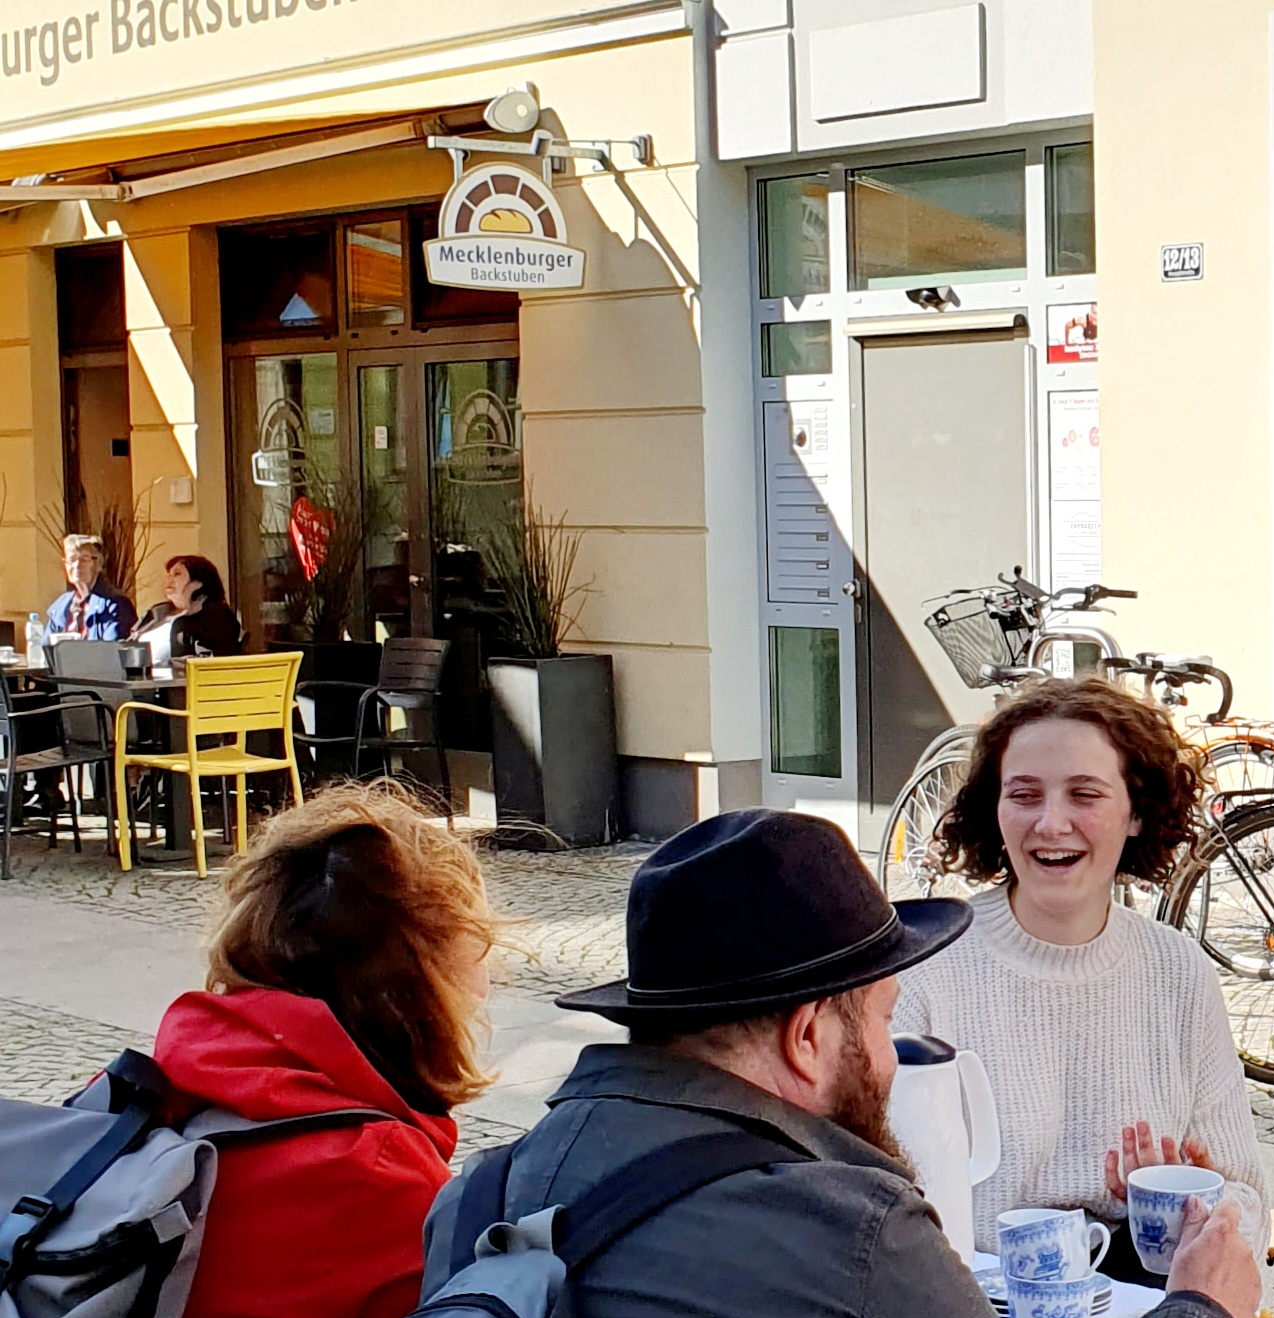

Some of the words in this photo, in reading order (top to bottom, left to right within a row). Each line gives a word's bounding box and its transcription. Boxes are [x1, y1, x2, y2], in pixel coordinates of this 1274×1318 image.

[439, 245, 574, 272] Mecklenburger
[1164, 247, 1200, 271] 12/13
[471, 267, 545, 284] Backstuben
